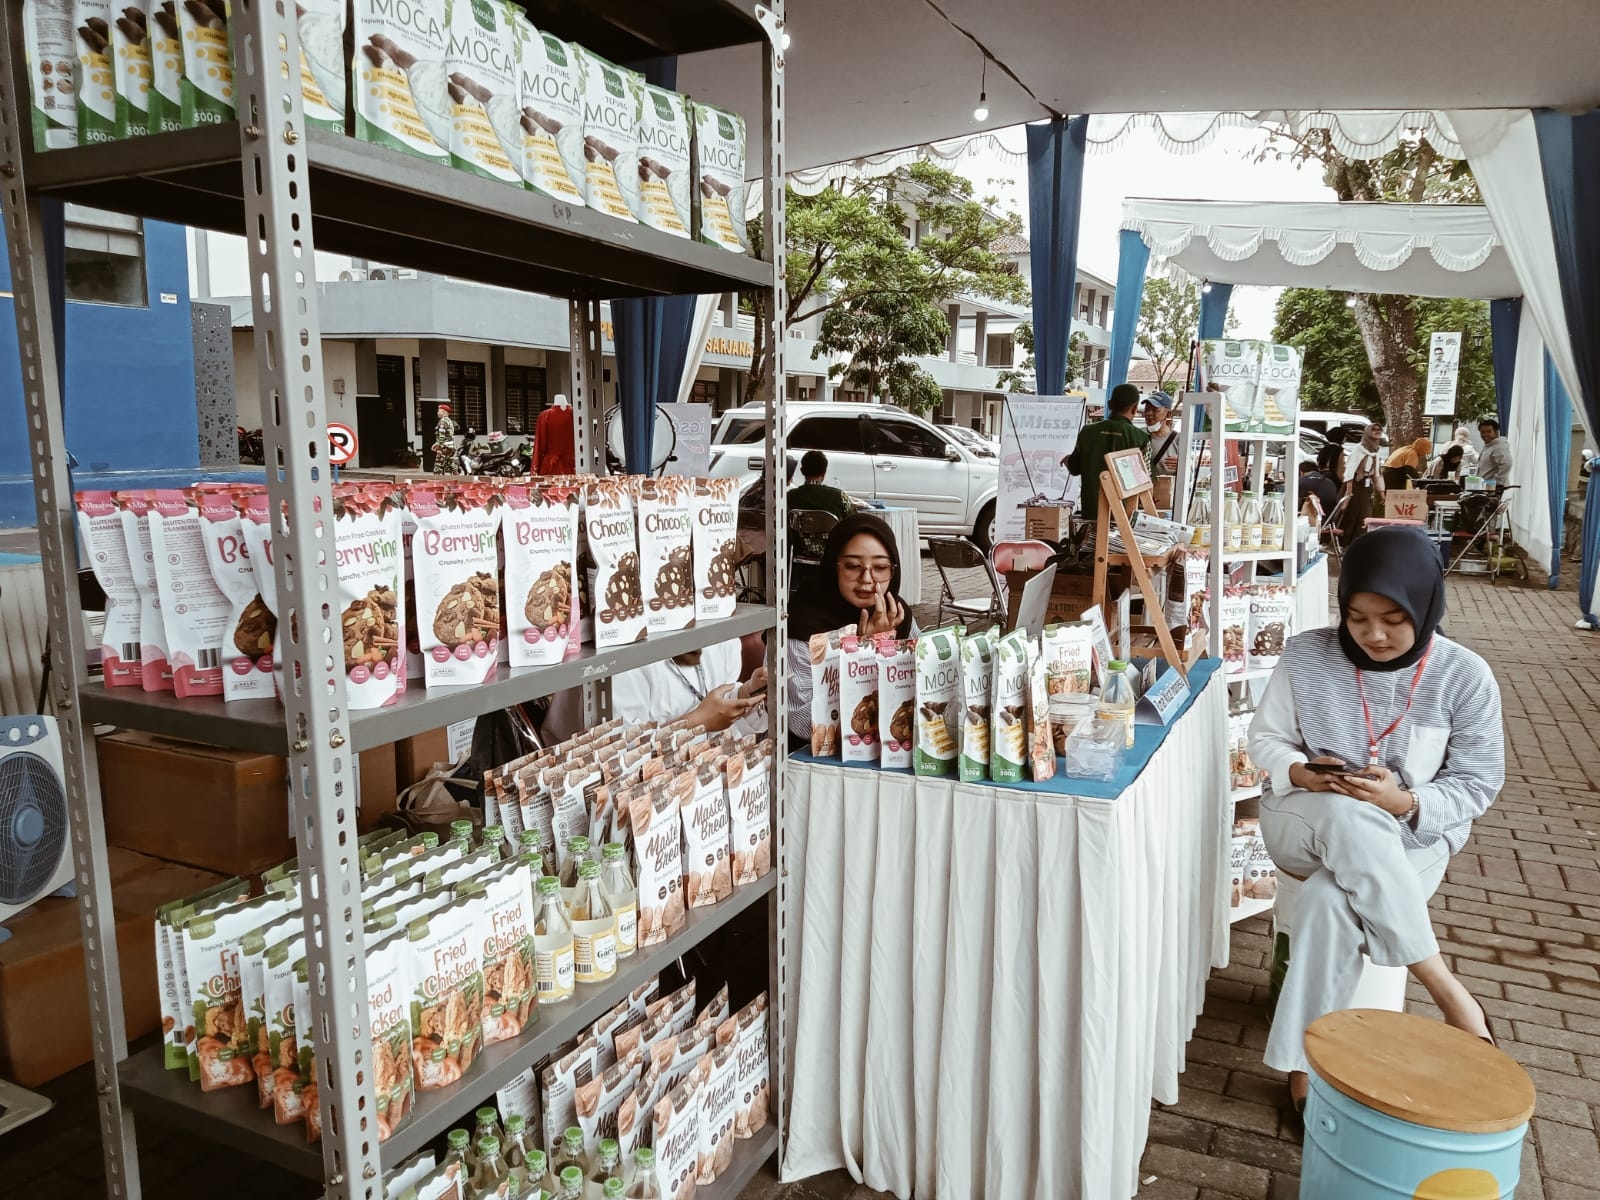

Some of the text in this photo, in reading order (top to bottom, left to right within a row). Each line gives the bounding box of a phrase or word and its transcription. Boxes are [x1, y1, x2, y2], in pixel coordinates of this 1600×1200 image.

[445, 33, 514, 78] MOCA
[523, 70, 580, 106] MOCA
[194, 112, 222, 124] 500g
[128, 127, 150, 137] 500
[639, 127, 688, 156] MOCA
[706, 337, 753, 358] SARJANA
[330, 432, 348, 456] P
[1394, 502, 1418, 516] Vit
[218, 535, 249, 564] Be
[1059, 644, 1080, 660] Fried
[886, 665, 915, 683] Berr
[1051, 659, 1087, 673] Chicken
[925, 668, 959, 691] MOCA
[491, 902, 522, 933] Fried
[200, 942, 223, 953] Tepung
[483, 923, 528, 957] Chicke
[434, 937, 467, 972] Fried
[208, 969, 242, 998] Chi
[423, 957, 478, 998] Chicken
